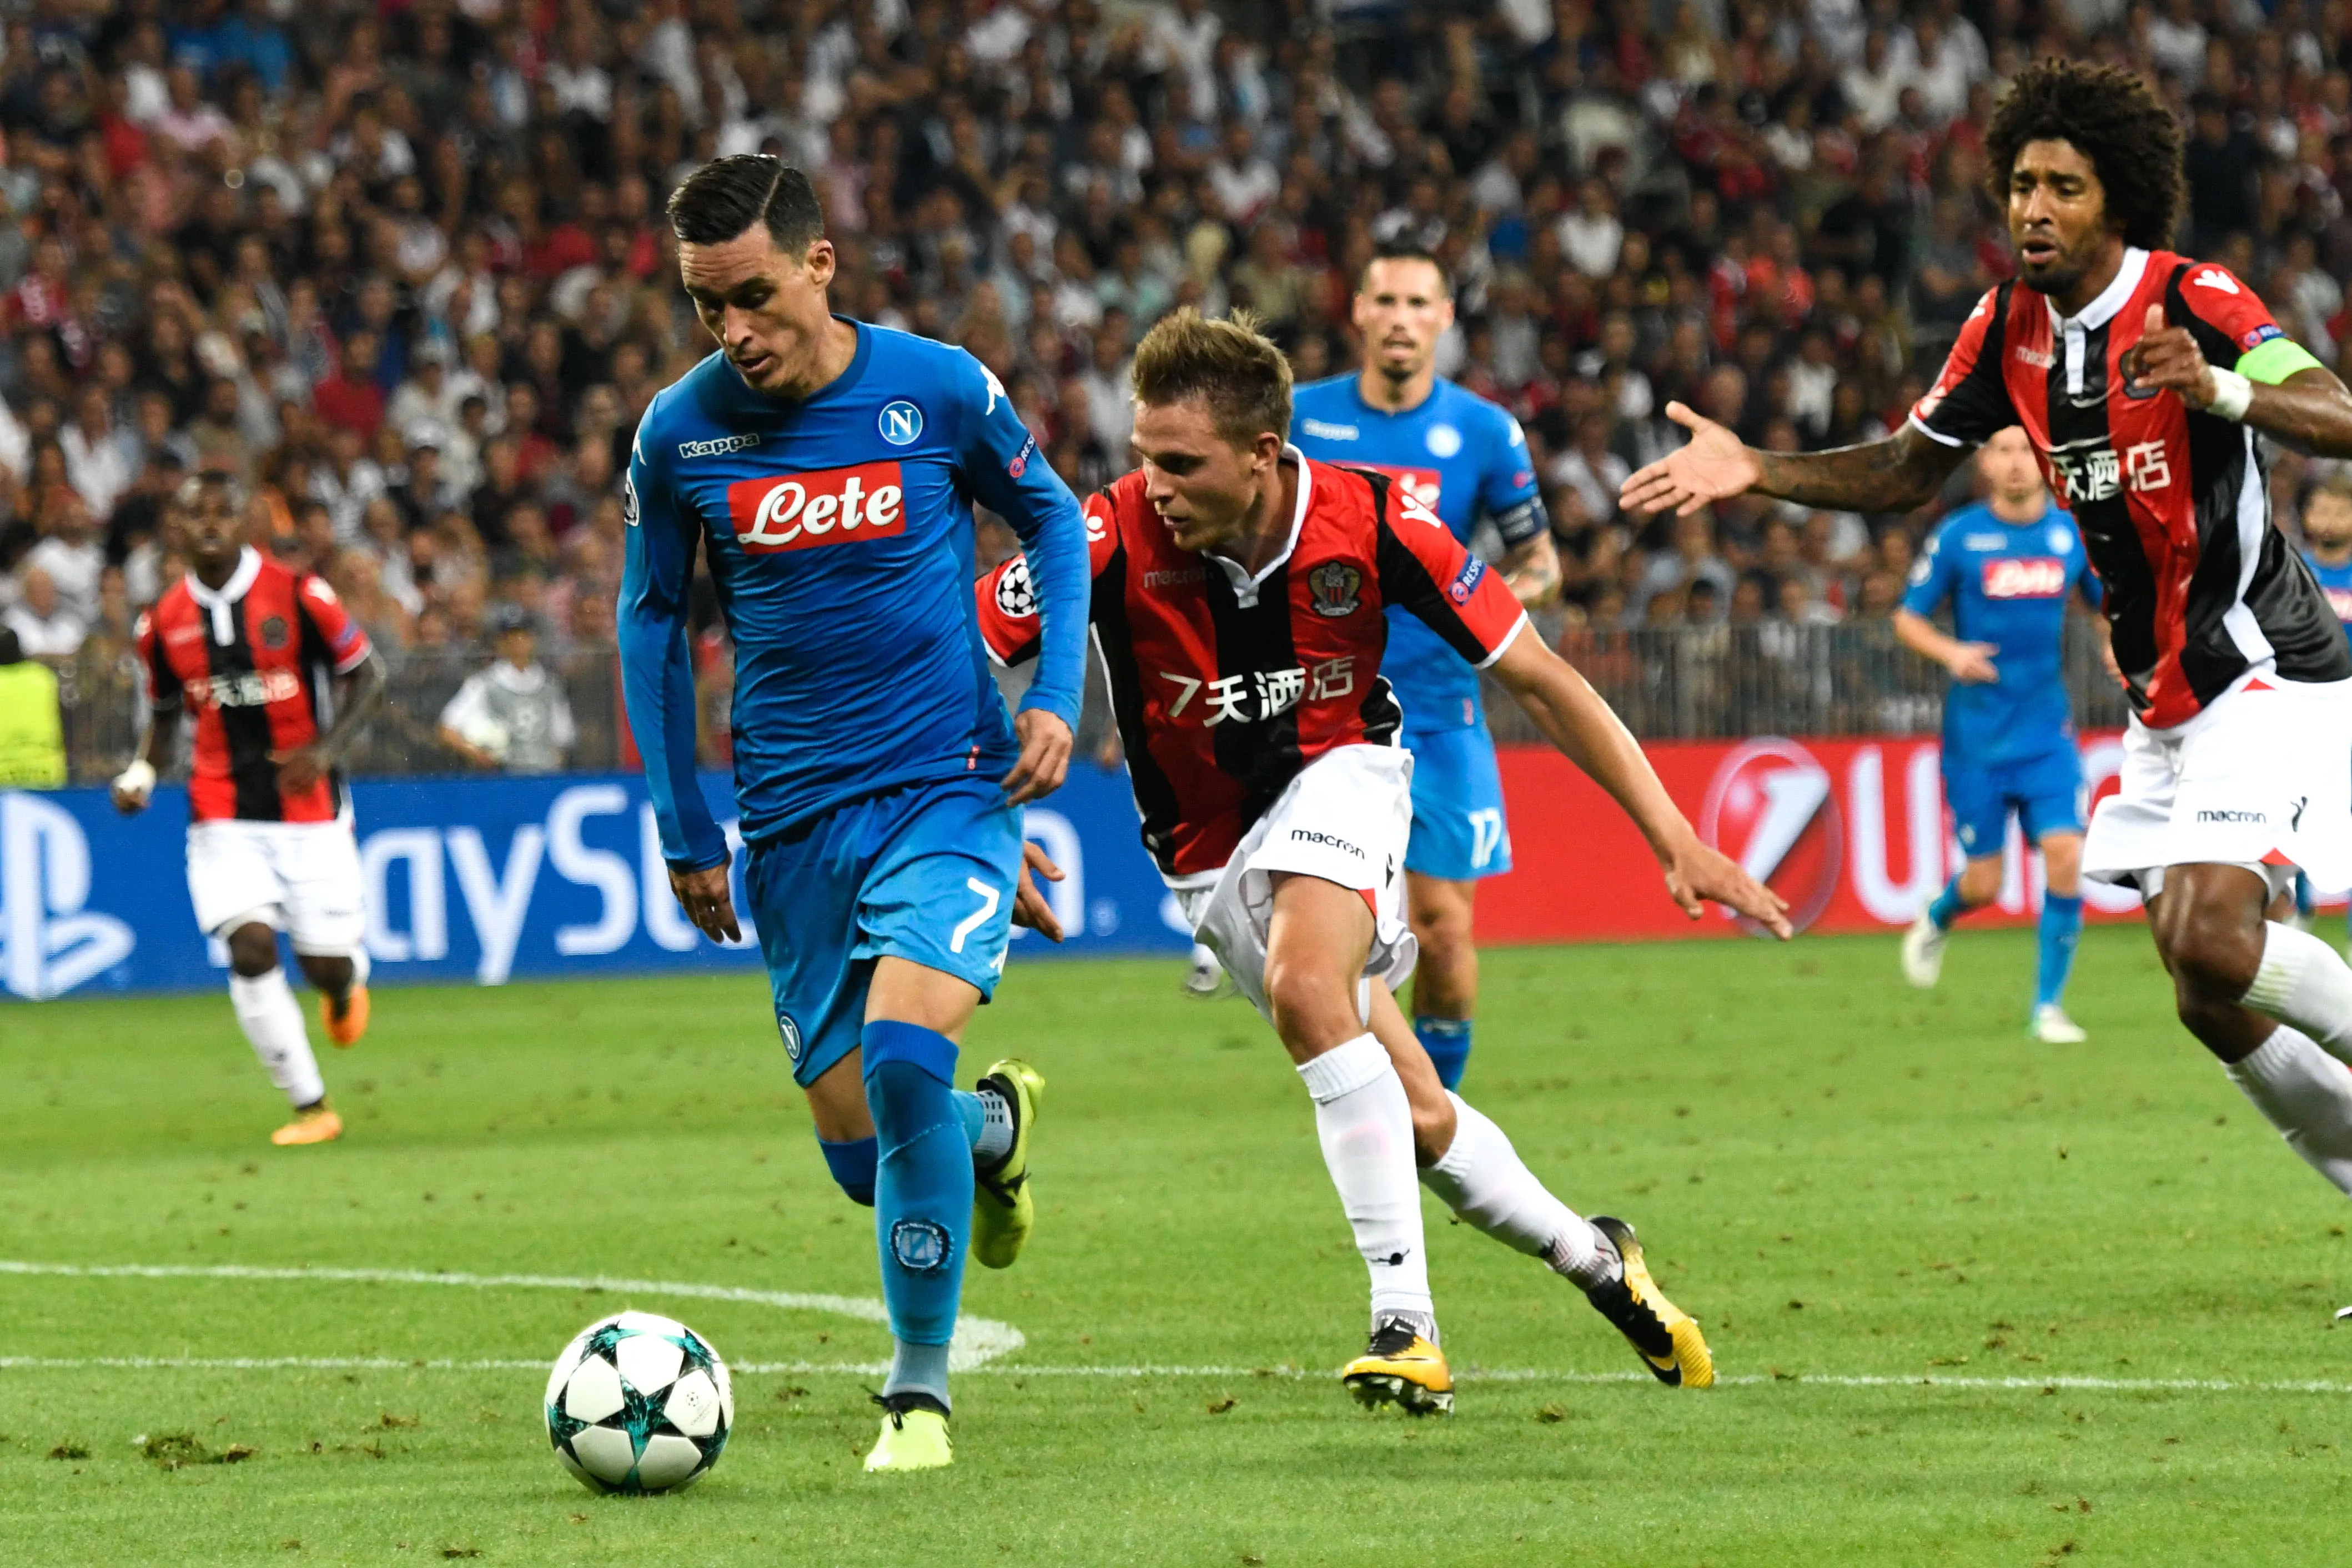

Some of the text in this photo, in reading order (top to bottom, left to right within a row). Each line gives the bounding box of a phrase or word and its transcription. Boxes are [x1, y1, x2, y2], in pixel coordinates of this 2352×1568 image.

[887, 409, 913, 436] N
[679, 433, 760, 459] Kappa
[737, 476, 902, 546] Lete
[1462, 556, 1482, 587] RESP
[2197, 810, 2267, 824] macron
[1291, 828, 1365, 861] macron
[1467, 806, 1502, 870] 17
[950, 876, 1000, 954] 7
